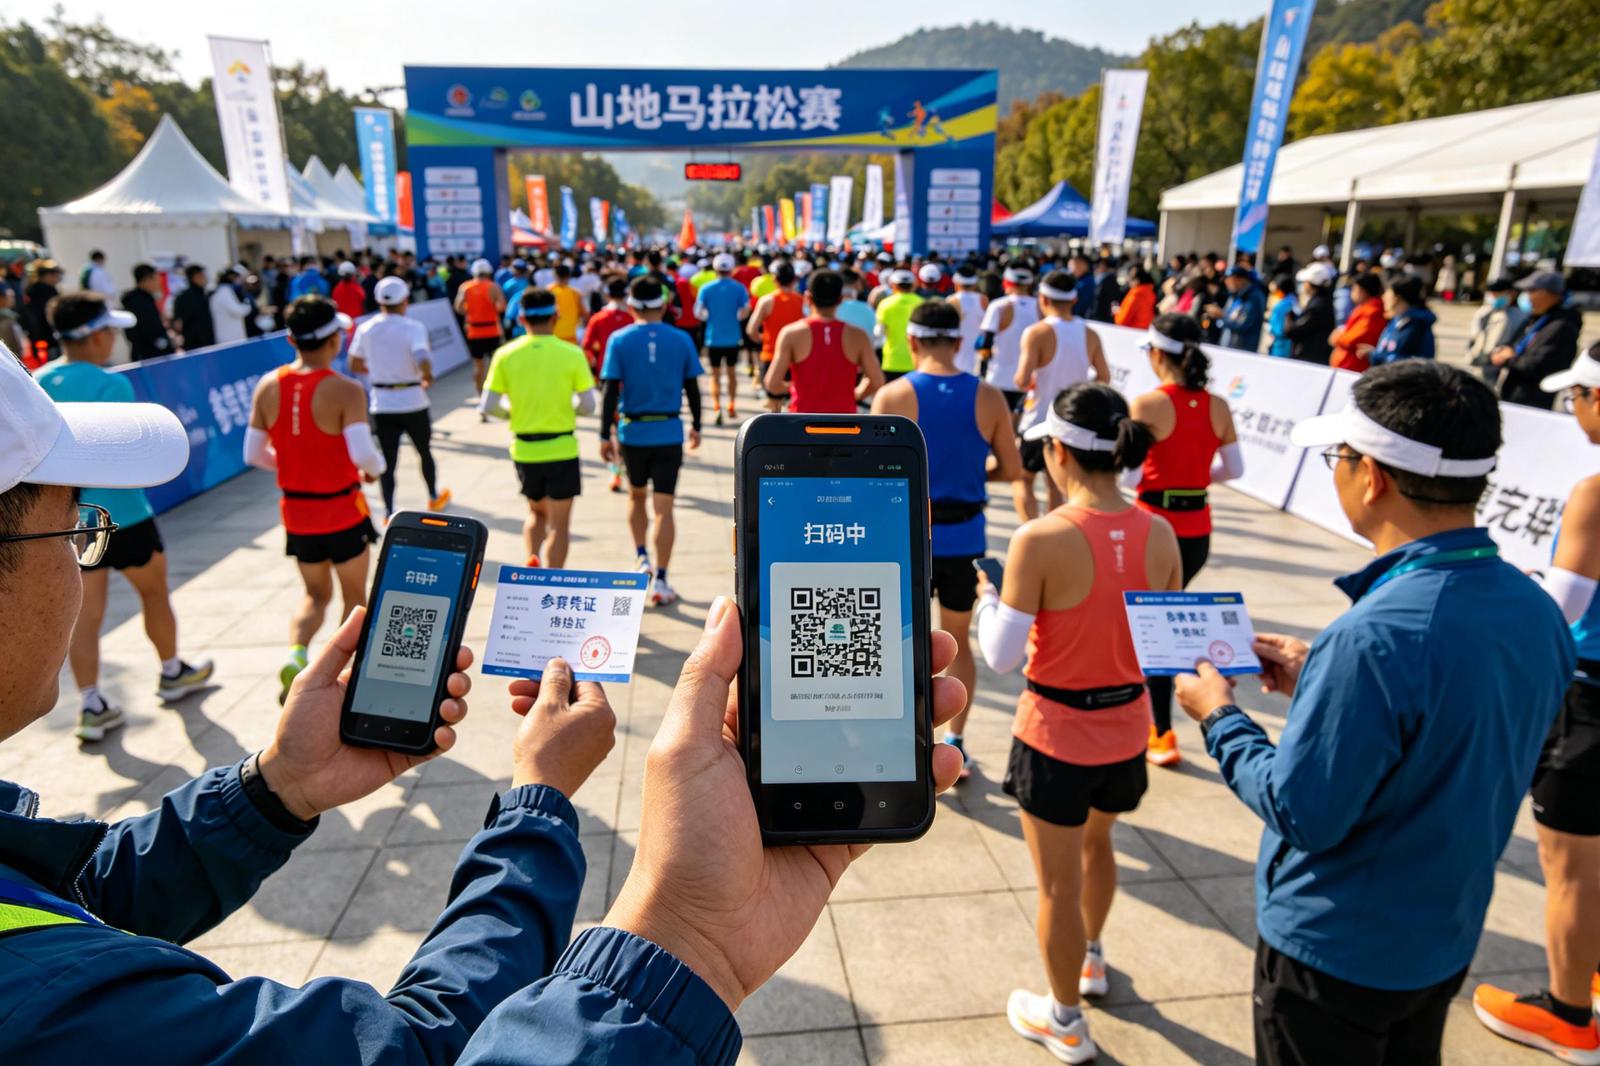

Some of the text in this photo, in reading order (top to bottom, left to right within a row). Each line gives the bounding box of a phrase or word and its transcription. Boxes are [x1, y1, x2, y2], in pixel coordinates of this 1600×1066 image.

[570, 83, 841, 131] 山地马拉松赛
[804, 522, 865, 545] 扫码中
